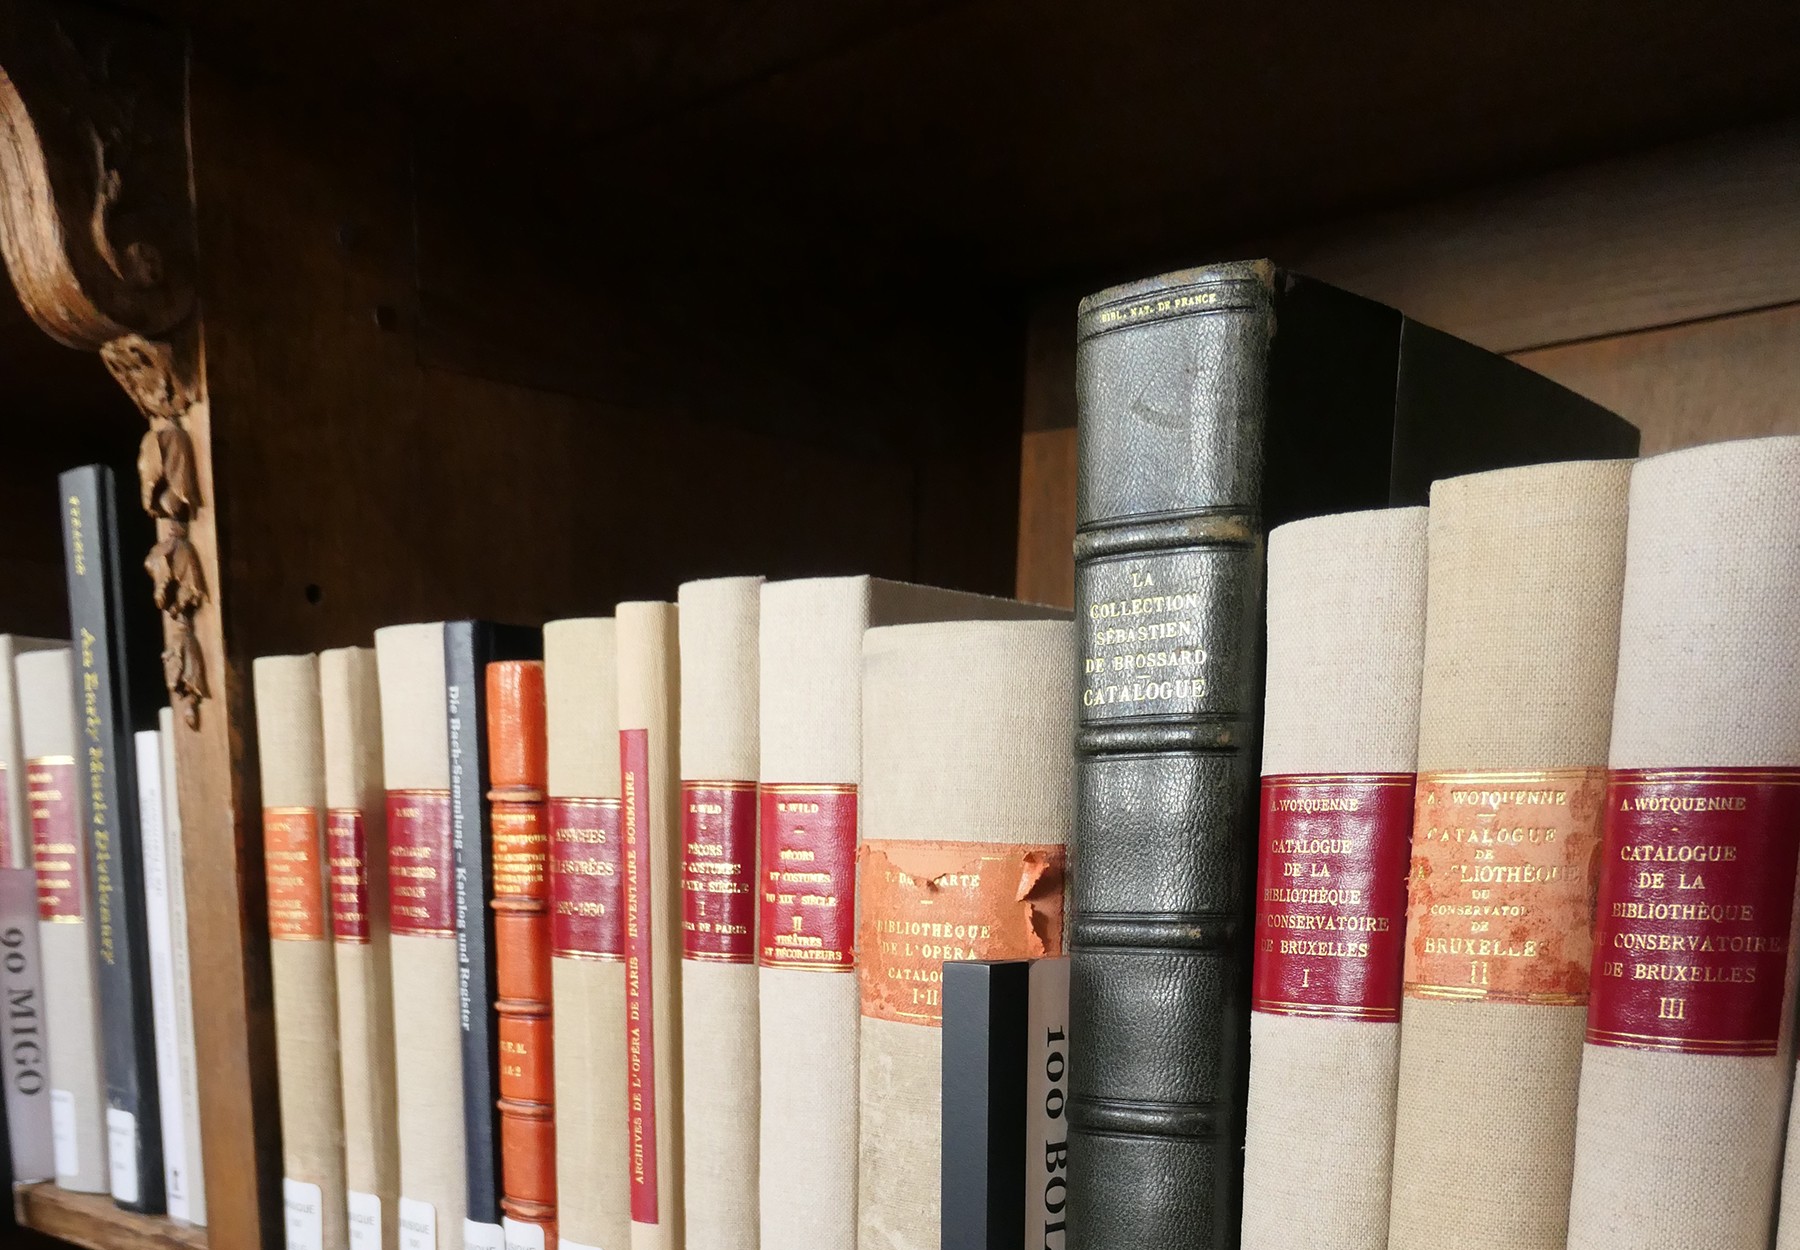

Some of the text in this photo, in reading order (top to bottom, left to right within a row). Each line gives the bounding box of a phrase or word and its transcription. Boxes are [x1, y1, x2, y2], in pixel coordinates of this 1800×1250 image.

[1101, 313, 1127, 323] BIBL.
[1131, 306, 1154, 317] NAT.
[1175, 294, 1217, 309] FRANCE
[1132, 572, 1154, 588] LA
[1090, 593, 1198, 619] COLLECTION
[1097, 621, 1191, 646] SÉBASTIEN
[1086, 649, 1207, 674] DE BROSSARD
[448, 685, 461, 714] Die
[1083, 679, 1206, 707] CATALOGUE
[88, 747, 108, 825] Music
[1271, 799, 1359, 815] A.WOTQUENNE
[1620, 797, 1747, 815] A.WOTQUENNE
[1271, 839, 1354, 854] CATALOGUE
[1475, 850, 1495, 860] DE
[1621, 845, 1737, 863] CATALOGUE
[1284, 863, 1331, 878] DE LA
[1640, 873, 1706, 890] DE LA
[1264, 886, 1362, 906] BIBLIOTHÈQUE
[1472, 889, 1491, 900] DU
[1611, 901, 1755, 922] BIBLIOTHÈQUE
[876, 918, 991, 939] BIBLIOTHÈQUE
[1267, 914, 1389, 932] CONSERVATOIRE
[1471, 921, 1490, 932] DE
[458, 933, 470, 963] und
[905, 944, 977, 961] L'OPÉRA
[1260, 938, 1369, 958] DE BRUXELLES
[1614, 933, 1781, 954] CONSERVATOIRE
[625, 771, 645, 1185] ARCHIVES DE L'OPÉRA DE PARIS INVENTAIRE SOMMAIRE
[1302, 969, 1310, 988] I
[1469, 961, 1489, 985] II
[1603, 961, 1757, 983] DE BRUXELLES
[460, 966, 471, 1033] Register
[1658, 997, 1686, 1020] III
[1, 926, 44, 1097] 90 MIGO
[1046, 1025, 1065, 1120] 100
